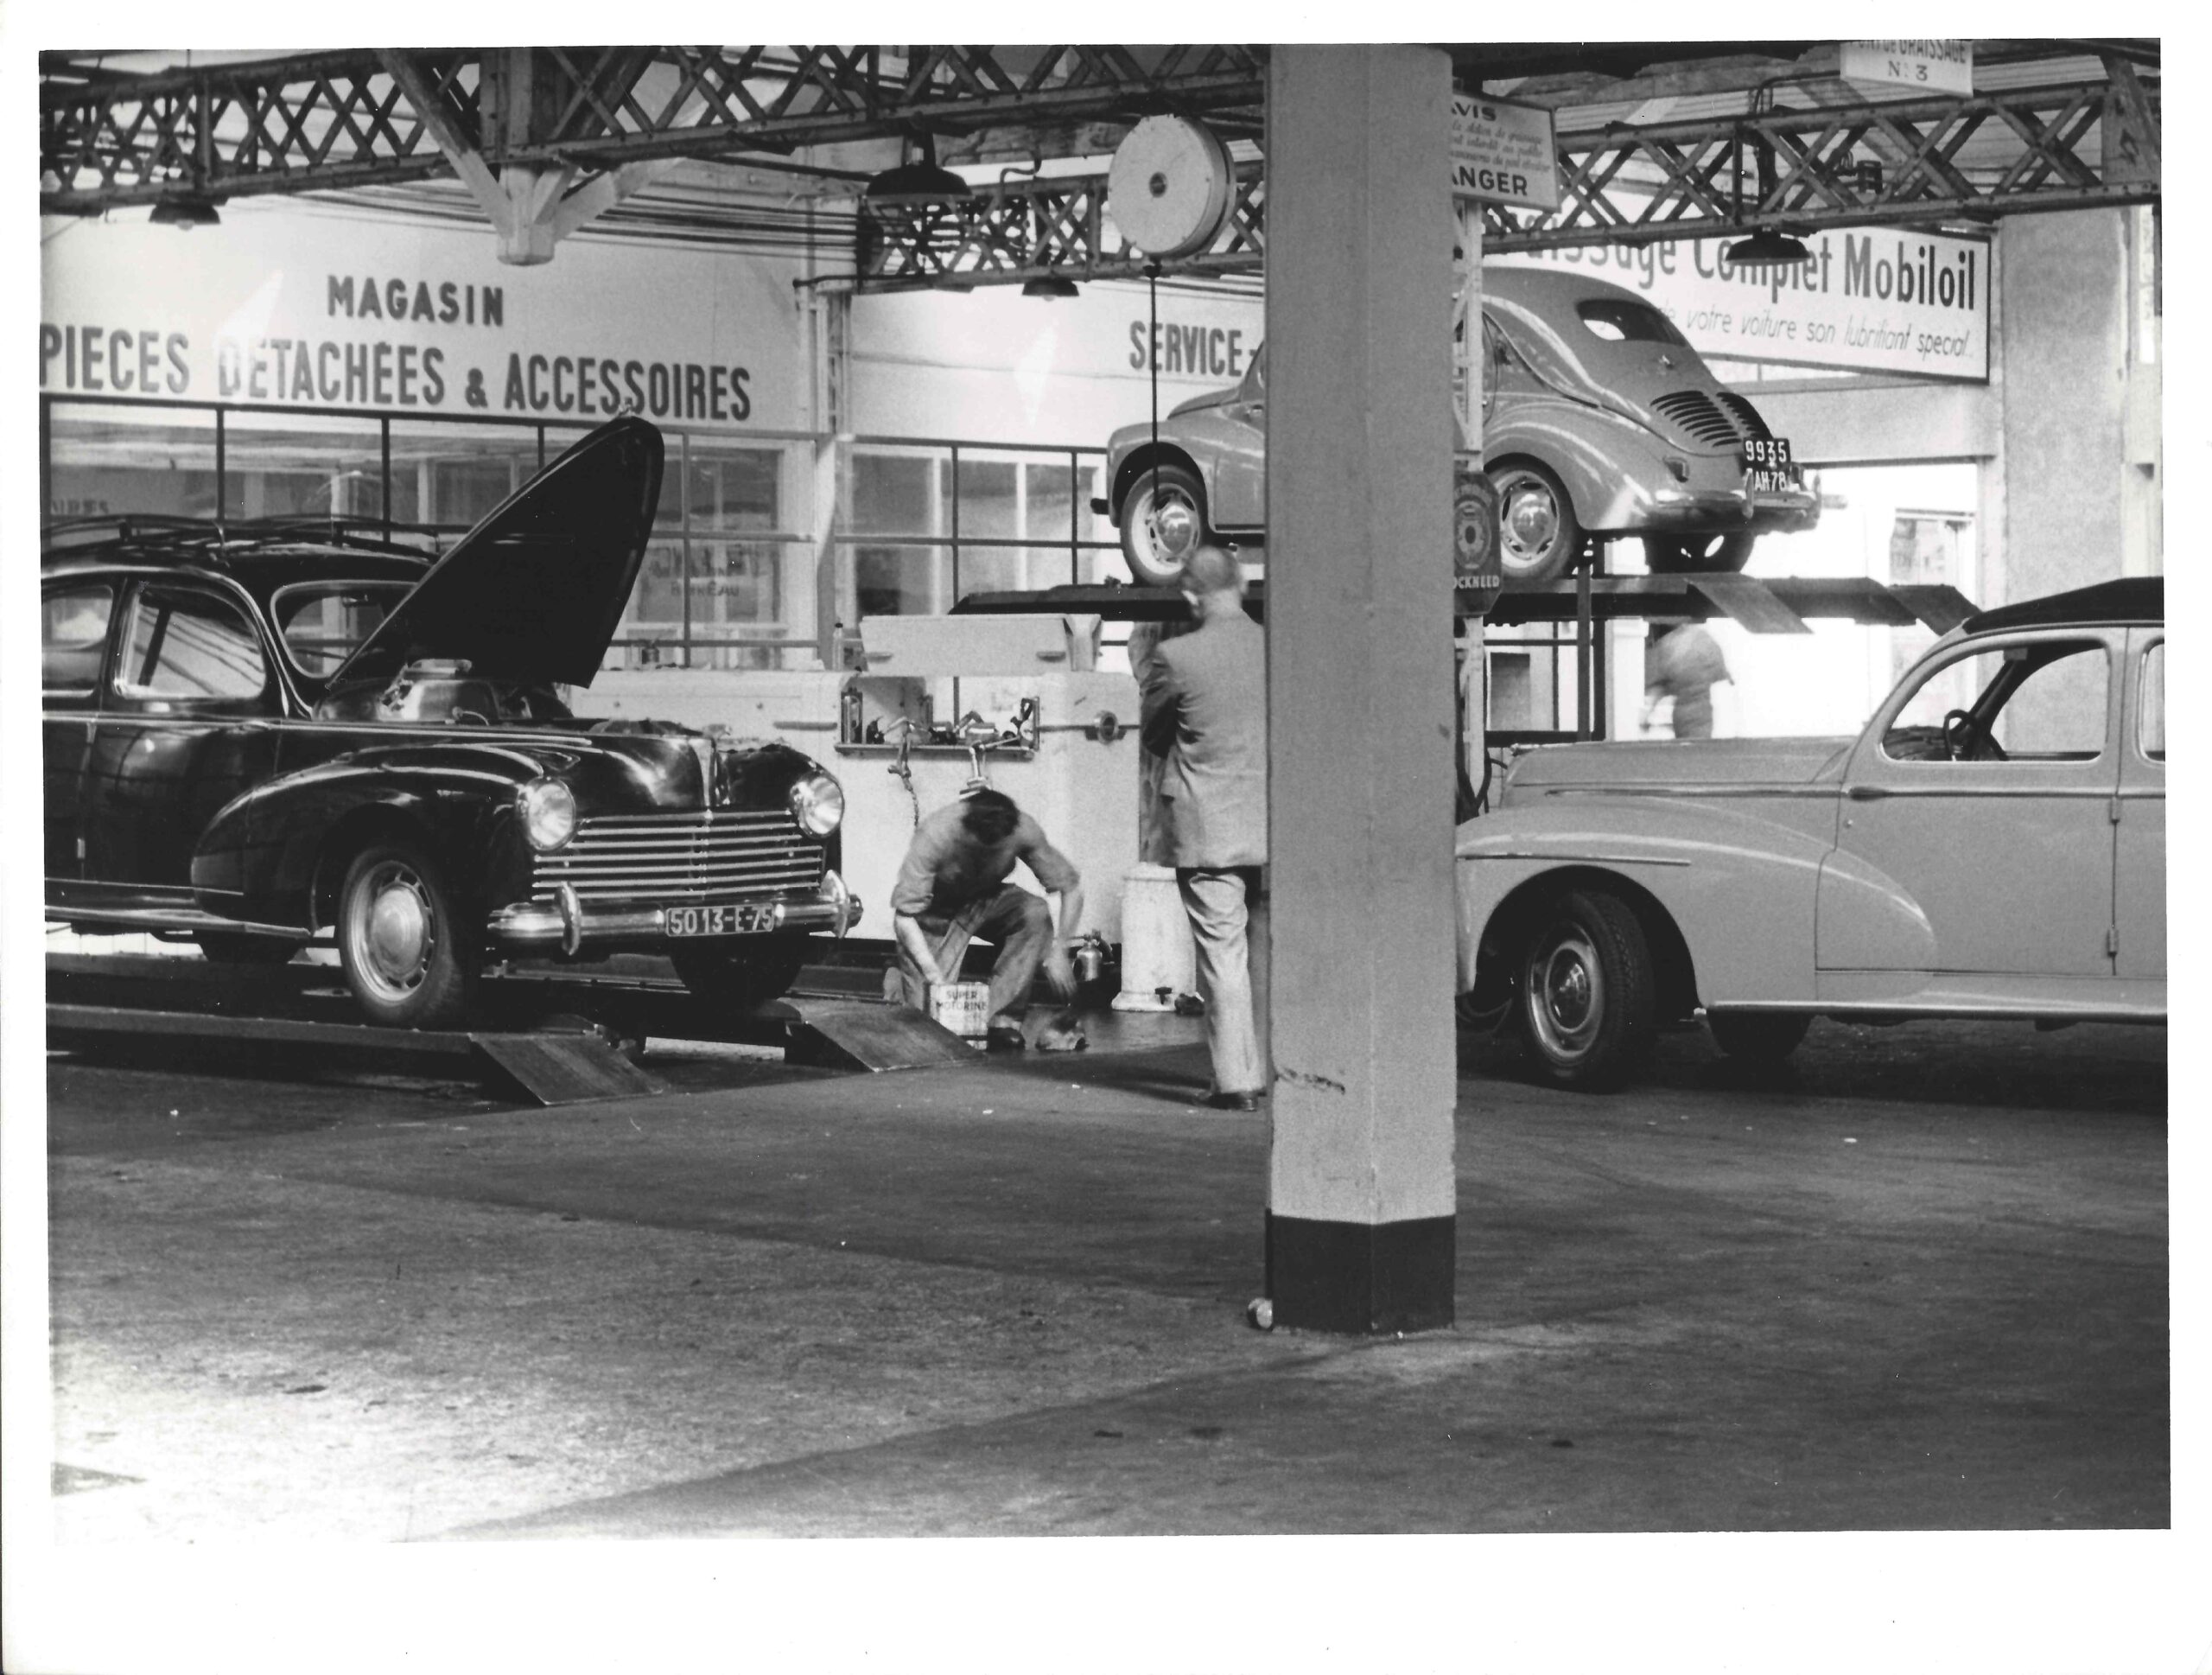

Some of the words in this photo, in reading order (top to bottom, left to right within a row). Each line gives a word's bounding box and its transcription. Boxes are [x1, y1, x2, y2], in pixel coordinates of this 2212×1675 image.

[1916, 64, 1929, 81] 3
[1844, 233, 1974, 310] Mobiloil
[327, 274, 504, 327] MAGASIN
[1129, 321, 1243, 377] SERVICE
[1687, 303, 1732, 334] votre
[1741, 308, 1797, 340] voiture
[1807, 322, 1836, 344] son
[1844, 313, 1912, 351] lubrifiant
[40, 322, 190, 394] PIECES
[464, 368, 488, 409] &
[504, 352, 751, 422] ACCESSOIRES
[1745, 440, 1787, 462] 9935
[946, 990, 977, 1000] SUPER
